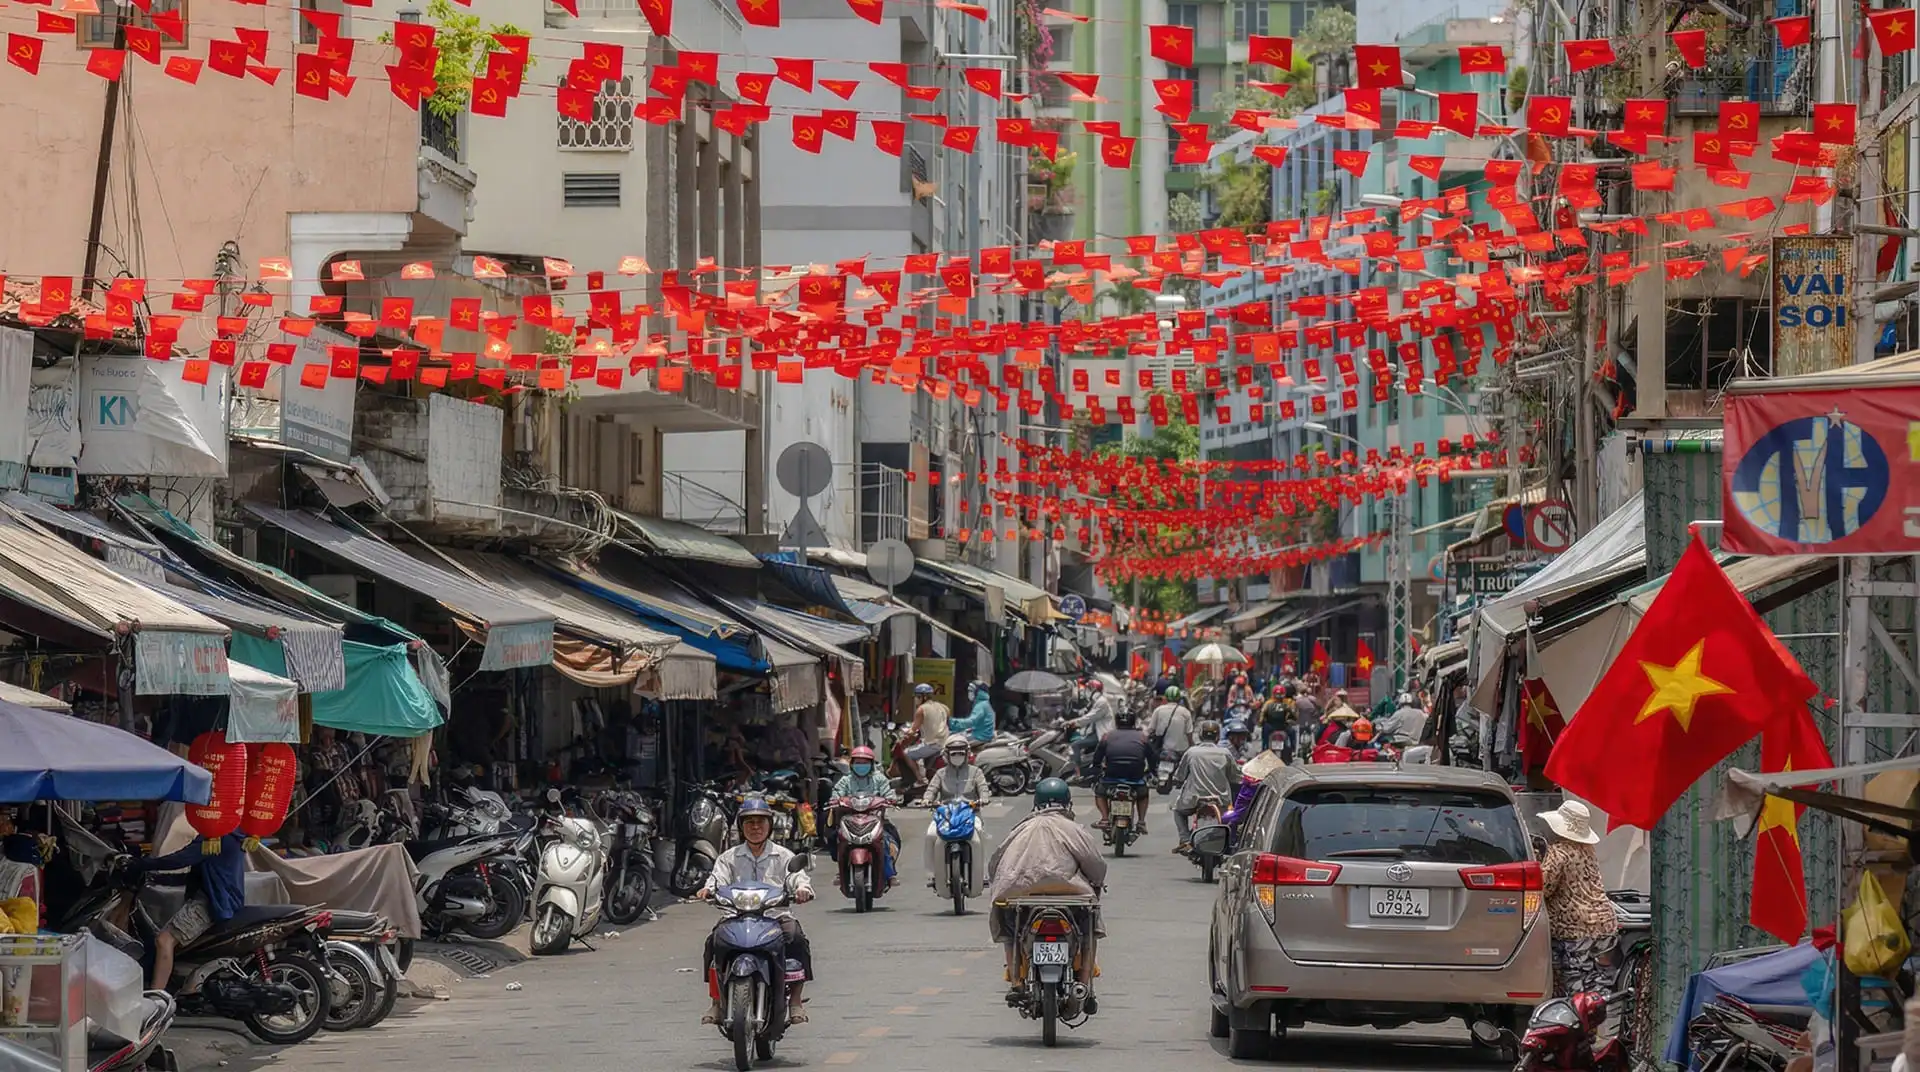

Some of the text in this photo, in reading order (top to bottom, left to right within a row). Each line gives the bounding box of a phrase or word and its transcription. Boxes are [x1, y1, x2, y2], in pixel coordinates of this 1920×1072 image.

[1781, 262, 1845, 296] VẢI
[1779, 304, 1846, 328] SOI
[1386, 889, 1412, 902] 84A
[1376, 901, 1422, 915] 079.24
